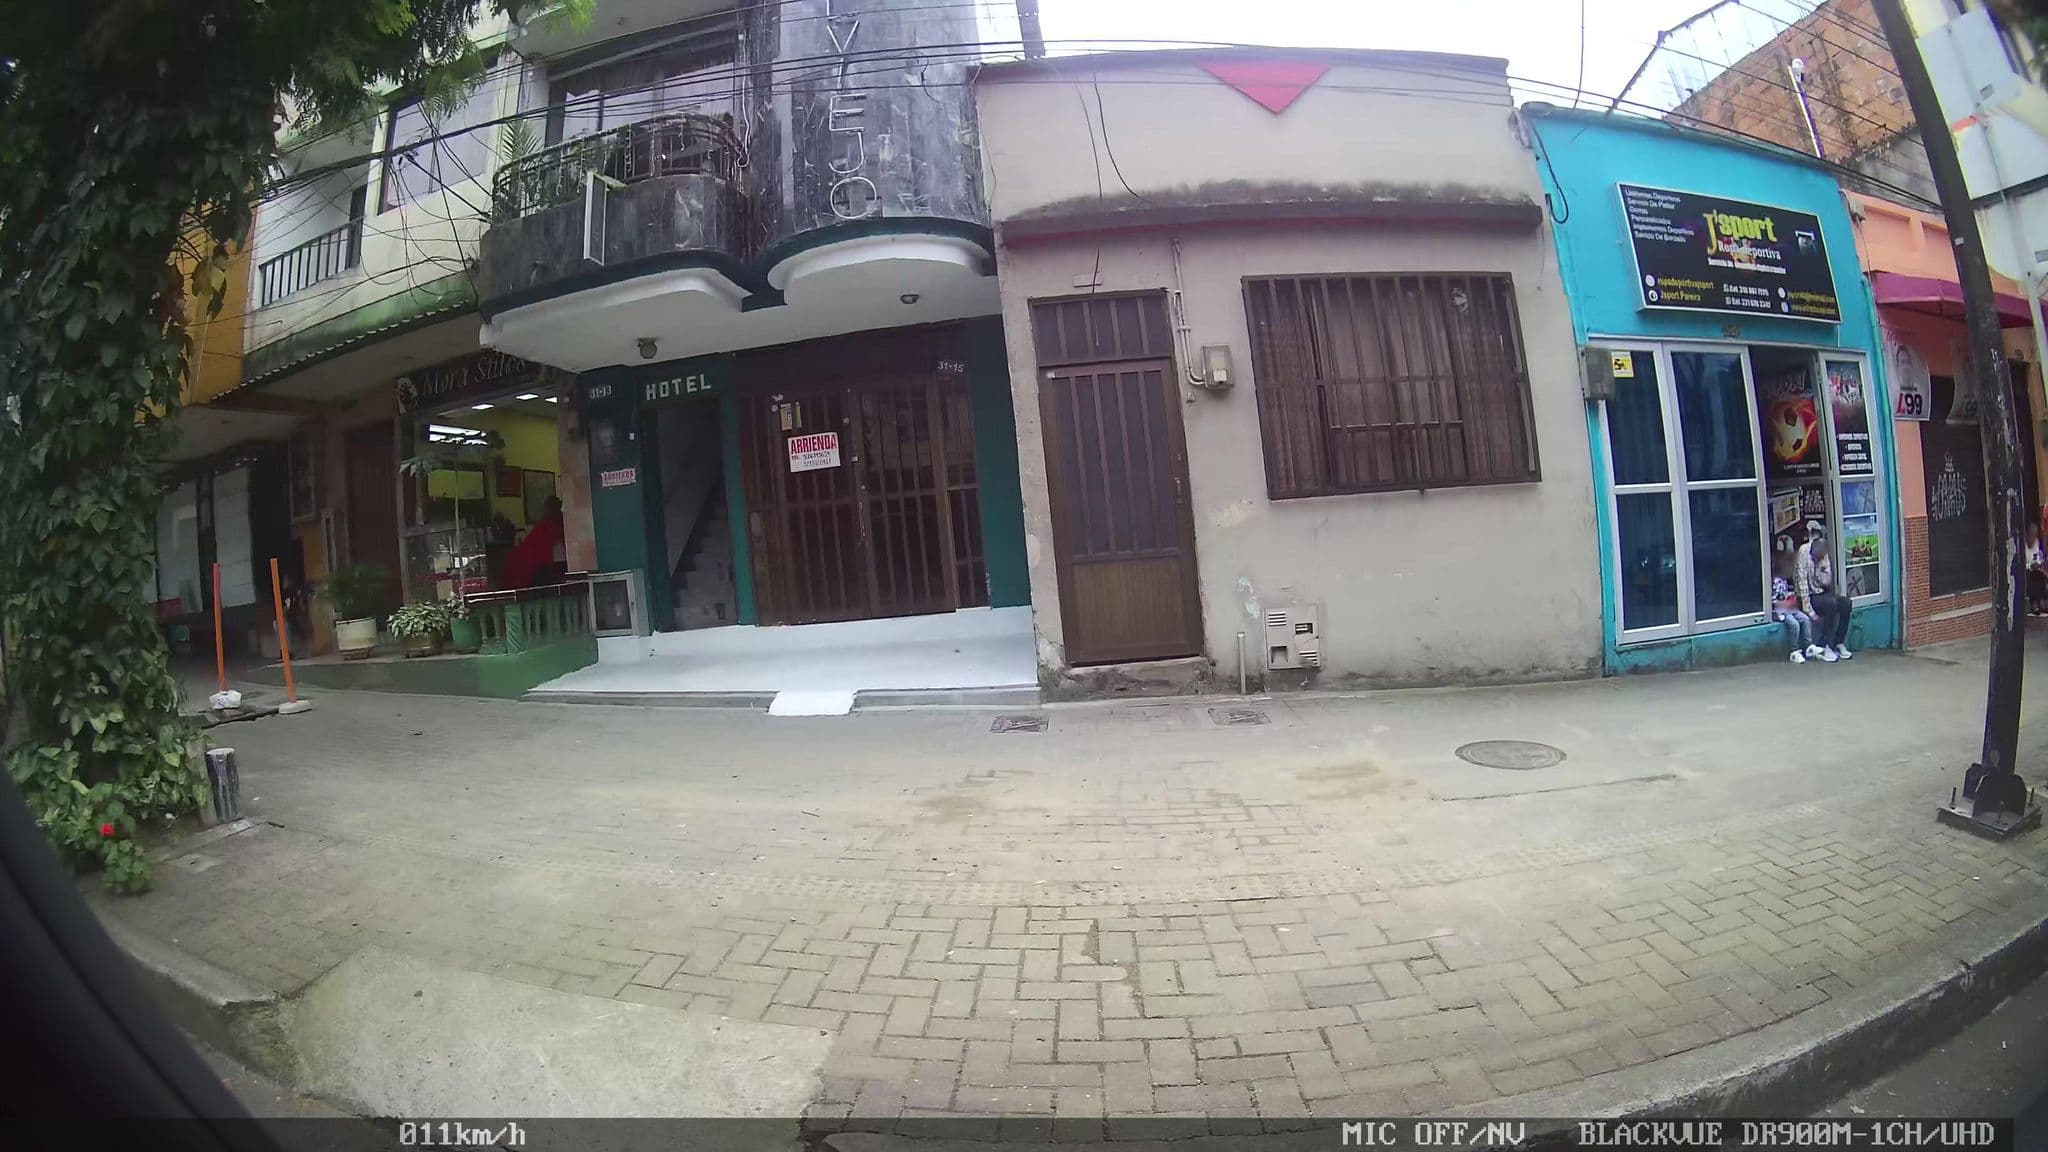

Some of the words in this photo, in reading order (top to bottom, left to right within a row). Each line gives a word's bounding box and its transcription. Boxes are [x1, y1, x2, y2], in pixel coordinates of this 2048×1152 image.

[938, 361, 964, 372] 31-15
[590, 385, 612, 399] 31-13
[646, 374, 711, 400] HOTEL
[791, 434, 837, 454] ARRIENDA
